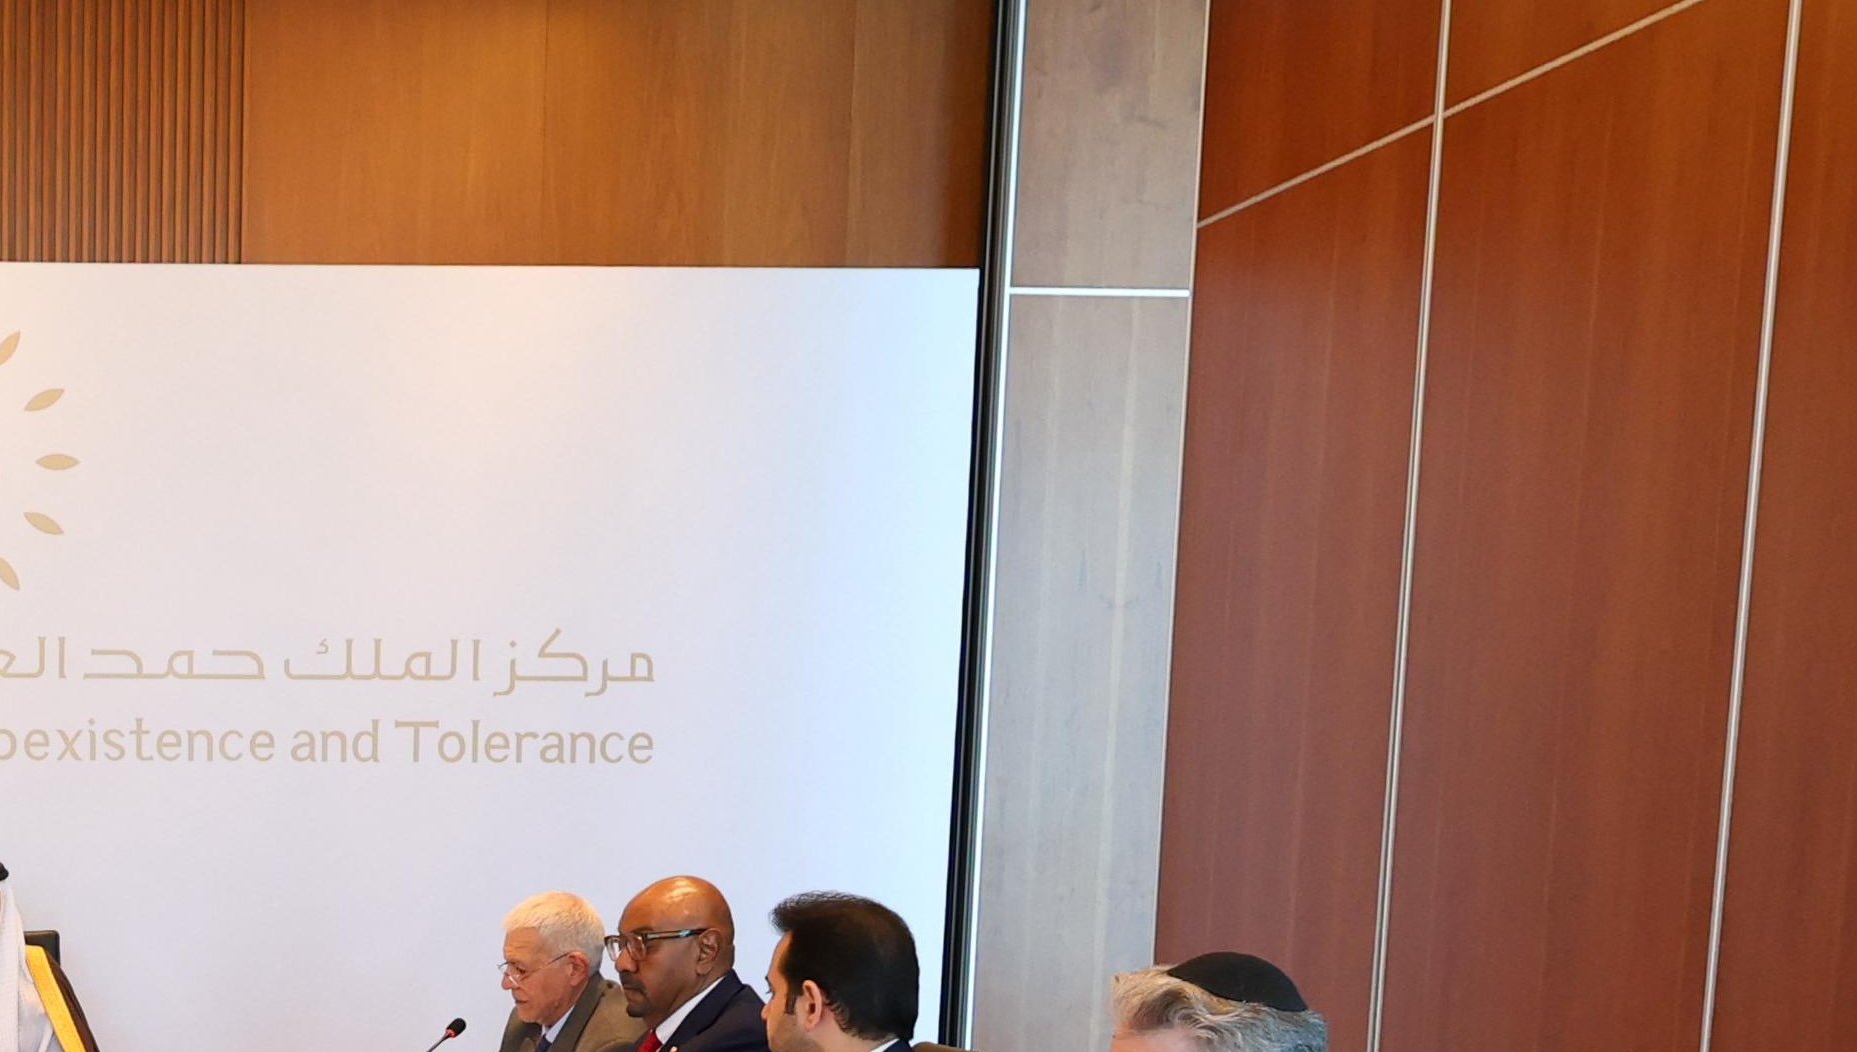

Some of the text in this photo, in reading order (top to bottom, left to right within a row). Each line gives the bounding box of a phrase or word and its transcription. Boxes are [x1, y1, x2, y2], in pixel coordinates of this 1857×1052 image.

[82, 646, 267, 682] حمد
[283, 636, 483, 682] الملك
[492, 628, 656, 698] مركز
[290, 719, 381, 764] and
[394, 719, 655, 765] Tolerance
